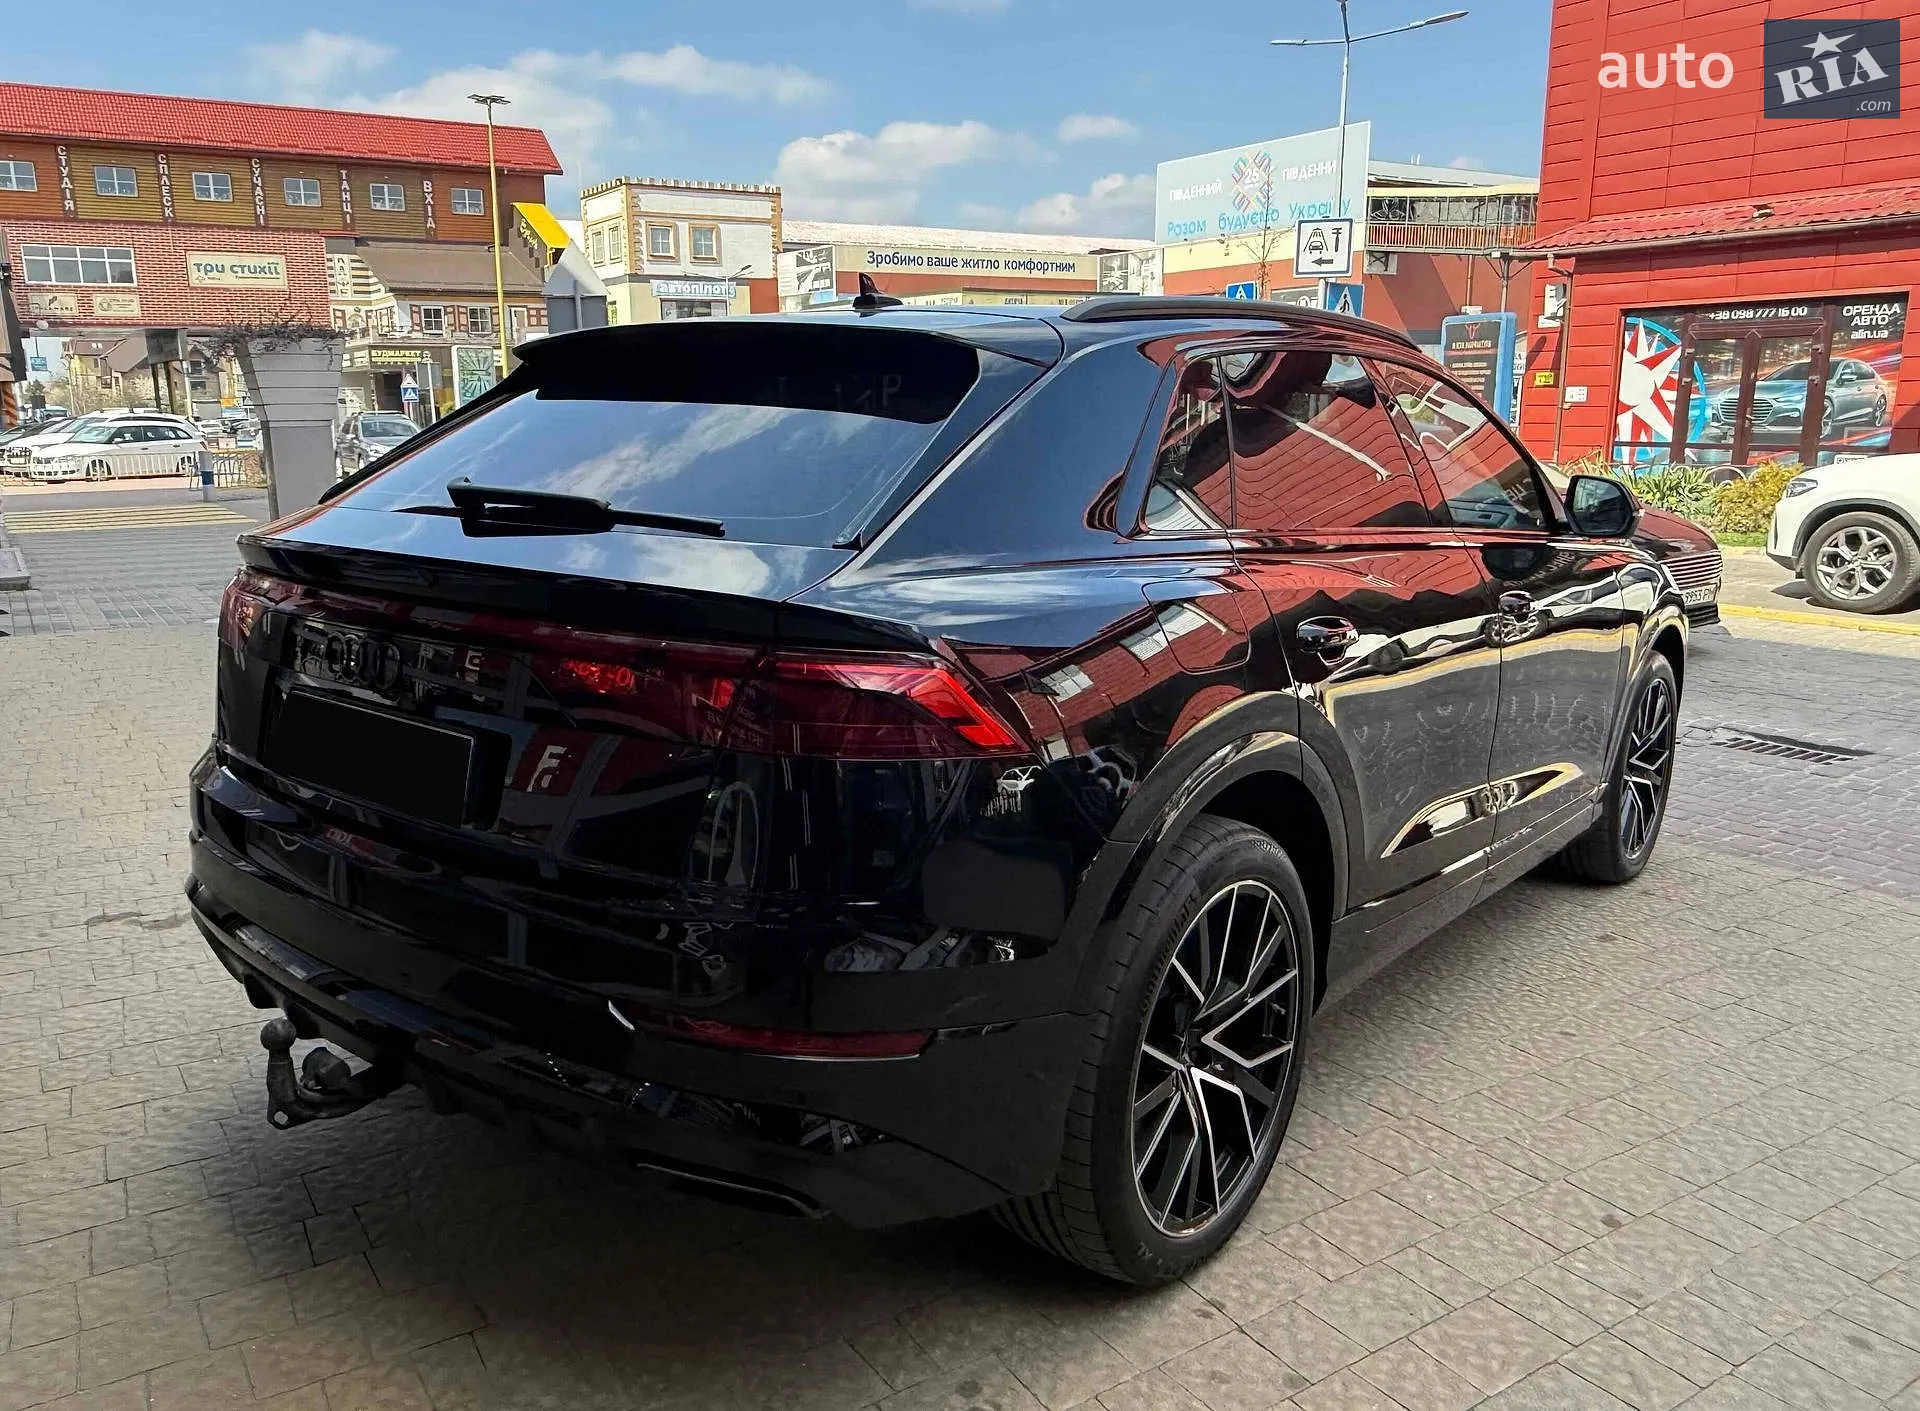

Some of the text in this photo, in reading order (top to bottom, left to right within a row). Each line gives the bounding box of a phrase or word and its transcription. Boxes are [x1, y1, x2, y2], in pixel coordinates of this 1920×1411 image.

[57, 145, 75, 211] СТУДІЯ
[158, 153, 174, 217] СПЛЕСК
[251, 158, 265, 226] СУЧАСНІ
[340, 170, 352, 224] ТАНЦІ
[866, 250, 1076, 275] Зробимо ваше житло комфортним
[1709, 305, 1808, 320] +38 098 777 16 00
[1842, 303, 1901, 316] ОРЕНДА
[1850, 315, 1889, 326] АВТО
